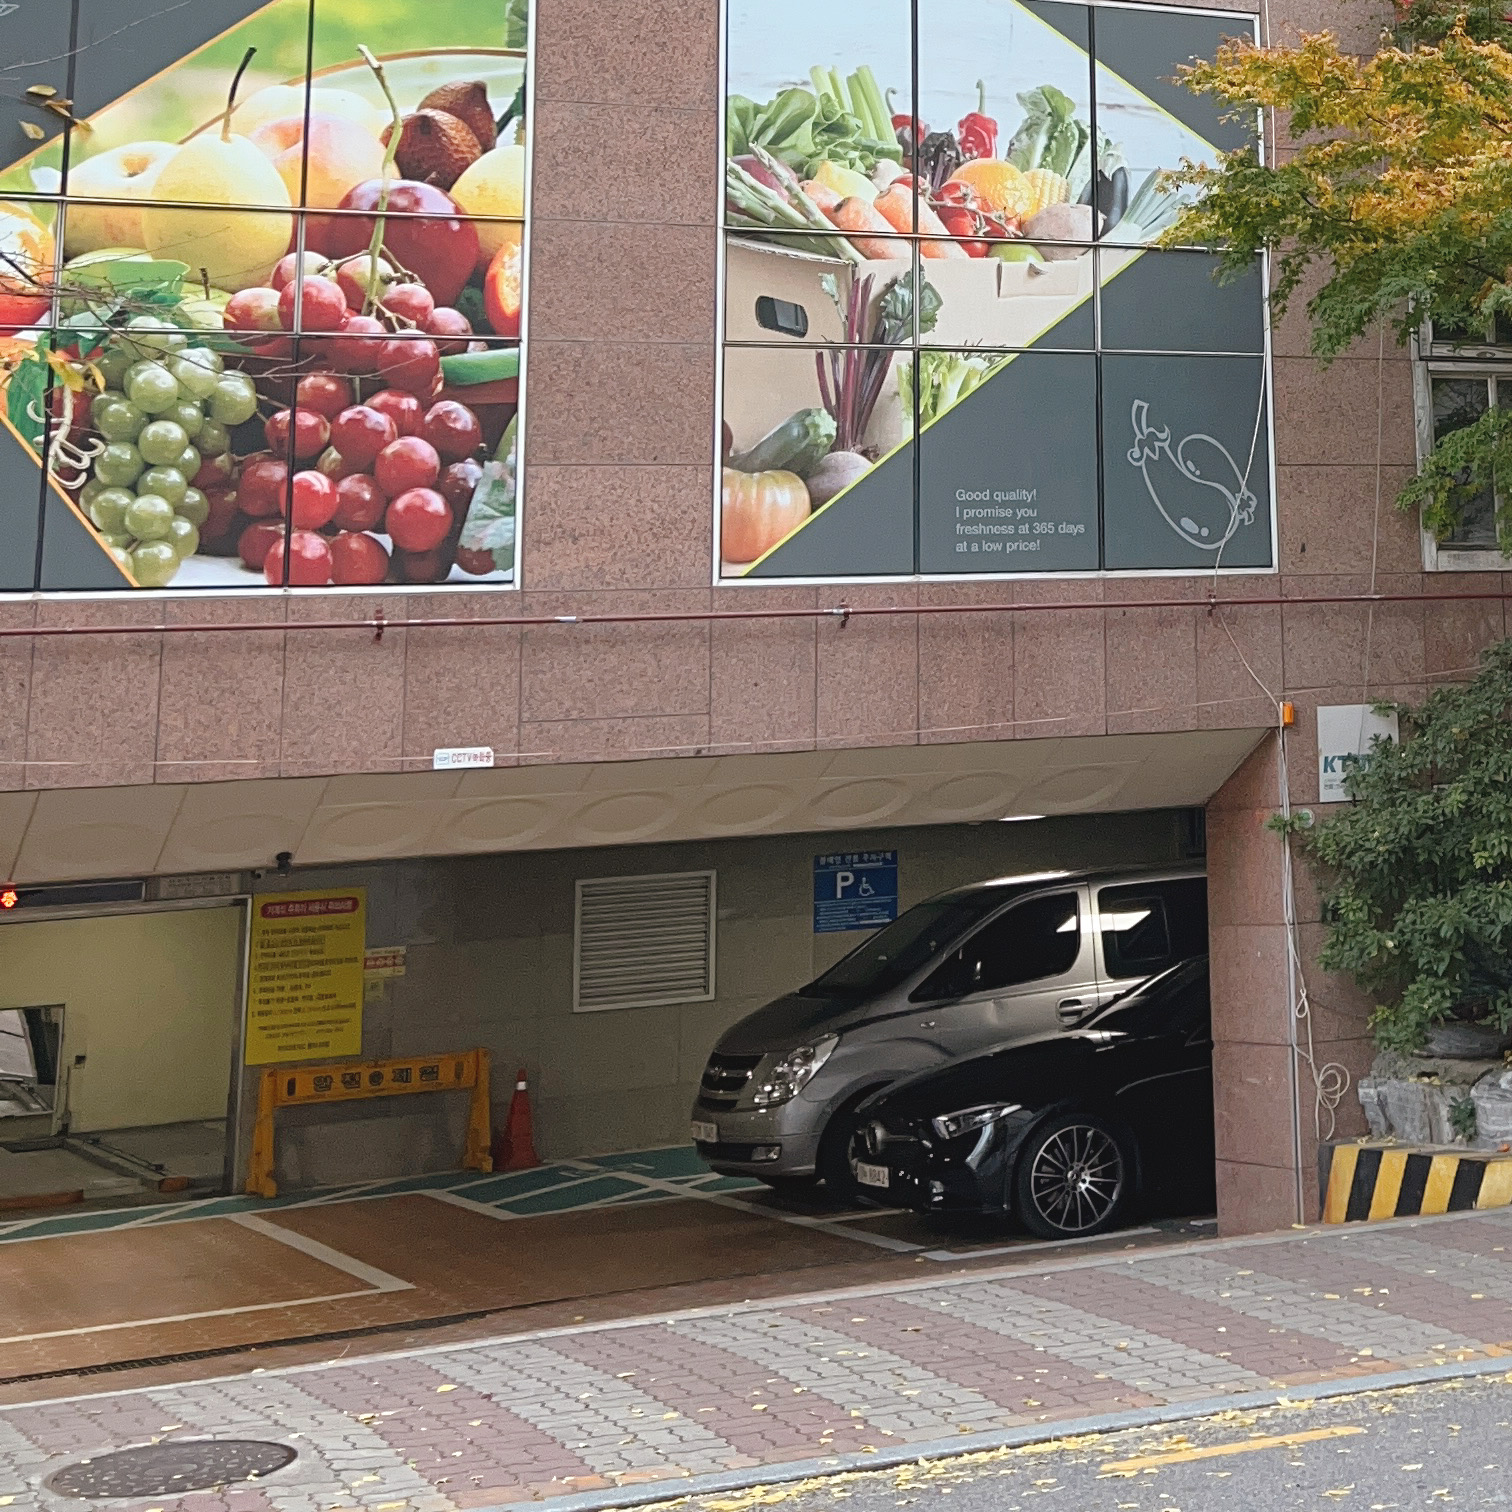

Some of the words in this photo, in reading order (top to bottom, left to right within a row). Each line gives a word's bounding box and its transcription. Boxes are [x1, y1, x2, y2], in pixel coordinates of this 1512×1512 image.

[955, 489, 990, 501] Good
[993, 489, 1037, 503] quality!
[955, 506, 960, 518] I
[963, 506, 1013, 520] promise
[1016, 508, 1037, 520] you
[955, 523, 1015, 535] freshness
[1018, 524, 1030, 534] at
[1032, 522, 1055, 534] 365
[1058, 522, 1085, 536] days
[955, 541, 967, 552] at
[971, 542, 979, 552] a
[982, 540, 1003, 552] low
[1006, 539, 1041, 553] price!
[836, 871, 855, 899] P
